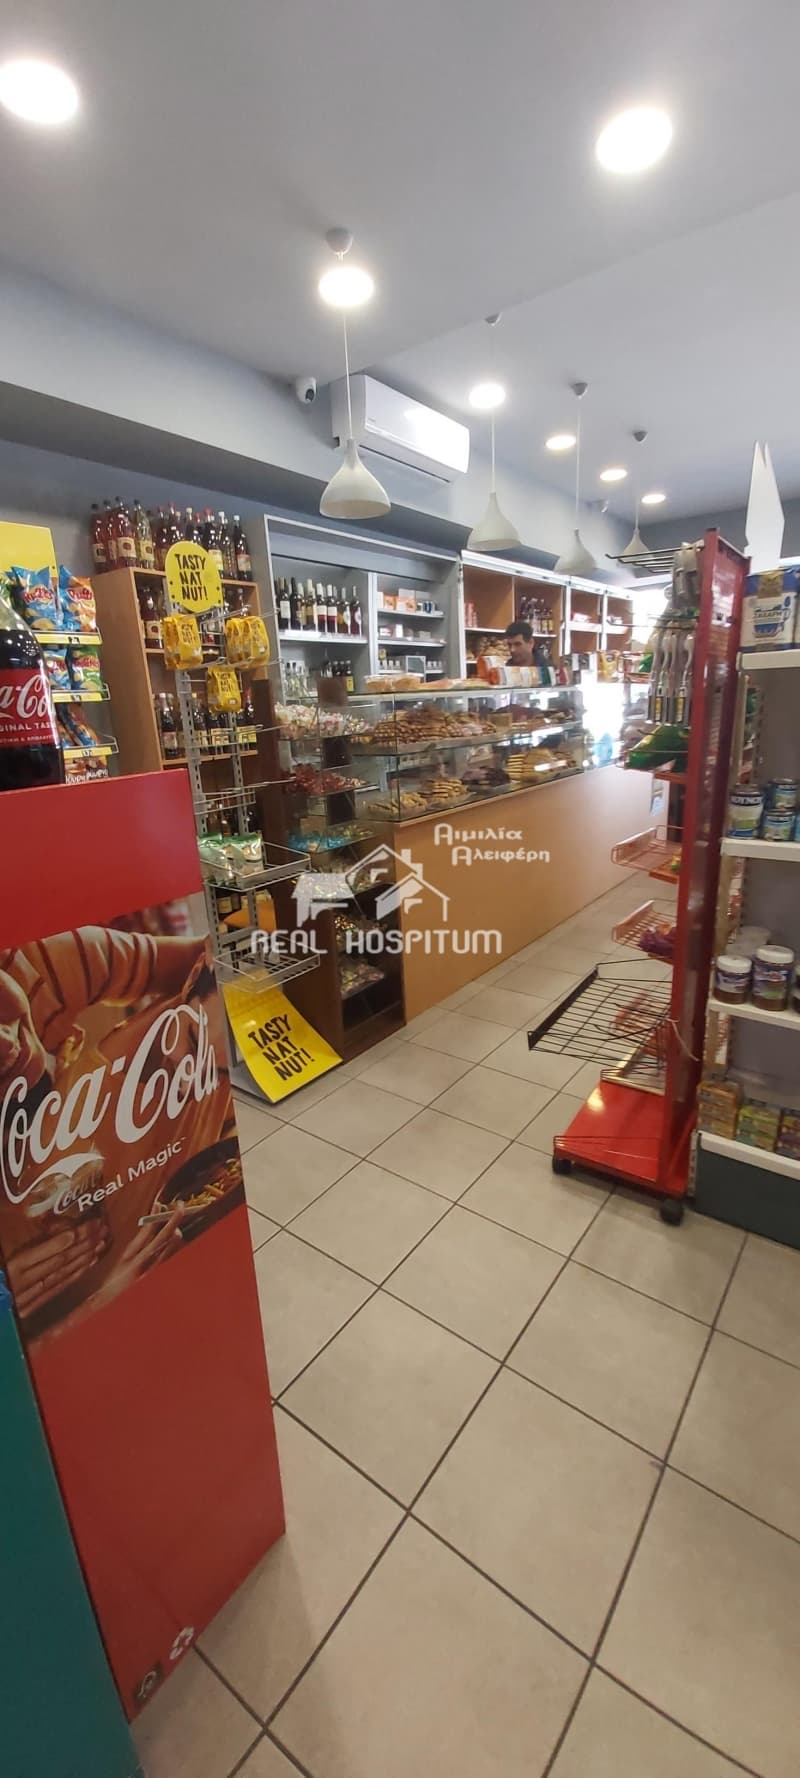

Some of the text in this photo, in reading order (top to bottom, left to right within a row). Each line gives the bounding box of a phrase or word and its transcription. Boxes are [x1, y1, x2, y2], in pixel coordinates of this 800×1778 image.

[174, 553, 206, 570] TASTY
[179, 570, 202, 585] NAT
[181, 585, 208, 601] NUT!
[248, 1014, 291, 1049] TASTY
[262, 1036, 298, 1065] NAT
[274, 1048, 315, 1081] NUT!
[0, 1004, 219, 1204] Coca-Cola
[77, 1141, 183, 1212] Real Magic
